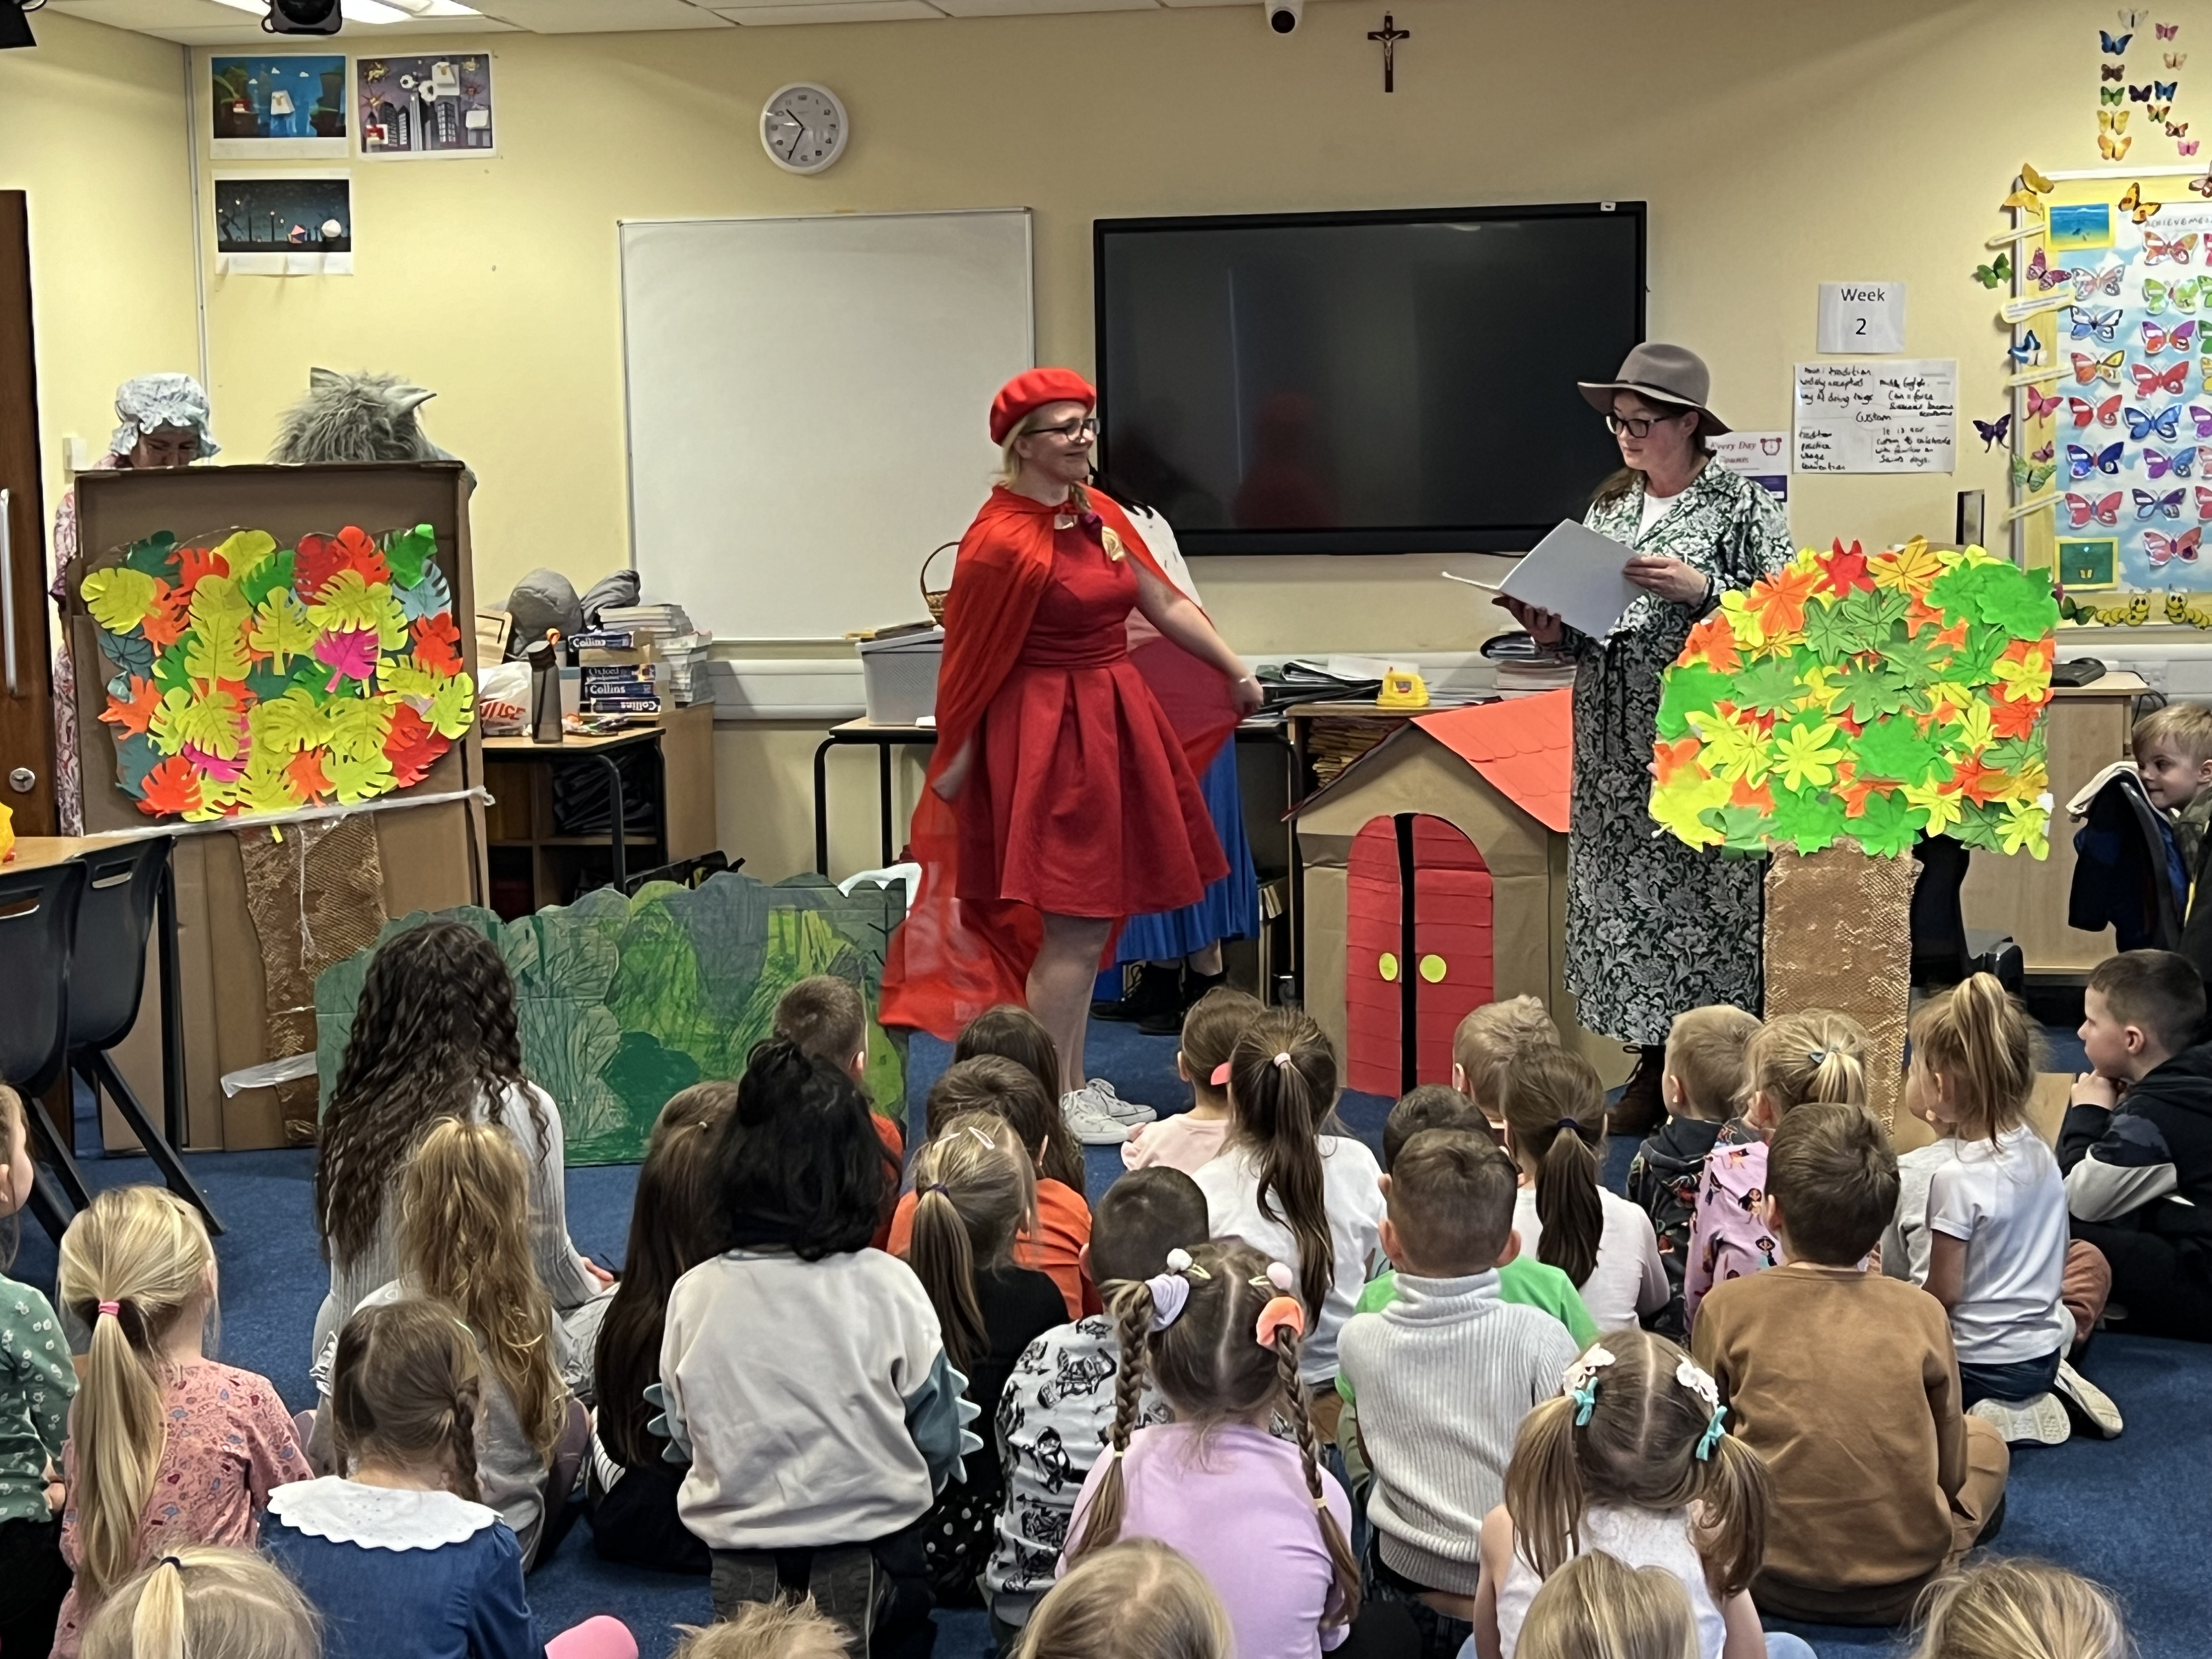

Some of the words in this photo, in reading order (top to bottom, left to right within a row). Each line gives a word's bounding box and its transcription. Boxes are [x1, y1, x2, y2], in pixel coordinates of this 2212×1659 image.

[1841, 289, 1886, 302] Week
[1855, 318, 1866, 335] 2
[1739, 441, 1757, 450] Day
[590, 683, 626, 693] Collins
[620, 701, 658, 710] Collins
